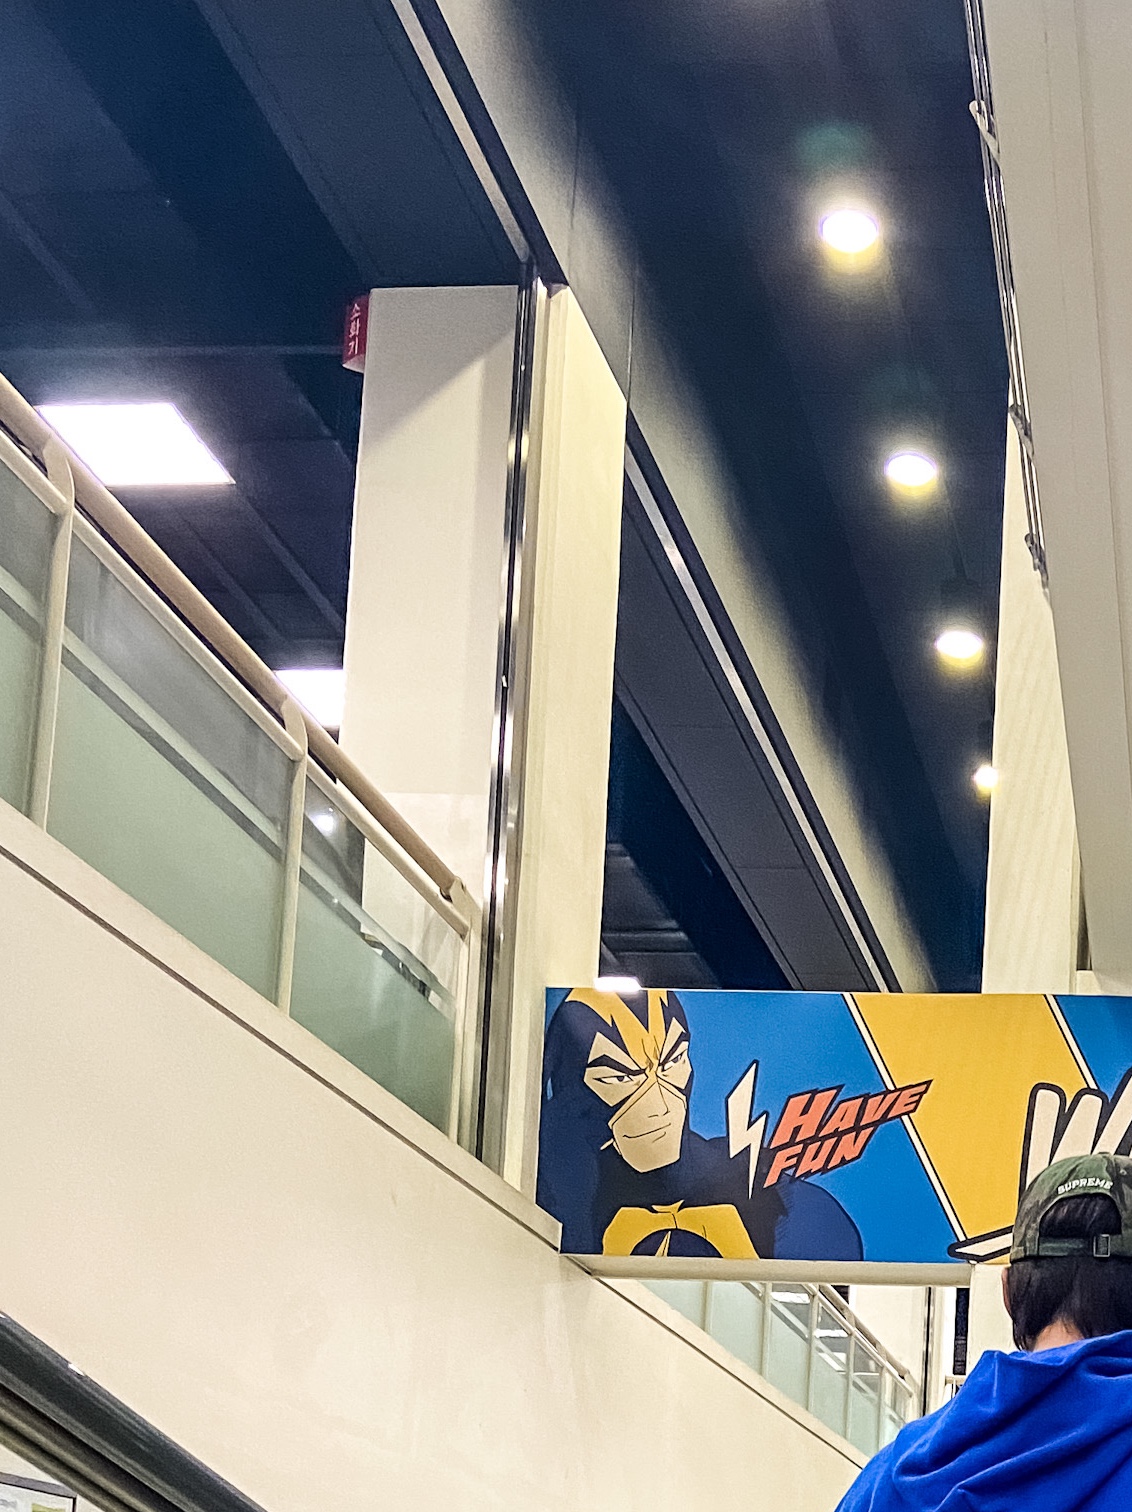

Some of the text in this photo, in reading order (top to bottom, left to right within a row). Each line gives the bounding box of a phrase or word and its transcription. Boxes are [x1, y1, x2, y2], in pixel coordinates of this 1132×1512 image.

[348, 302, 361, 356] 소화기
[768, 1080, 931, 1150] HAVE
[763, 1125, 877, 1188] FUN
[1057, 1177, 1113, 1195] SUPREME
